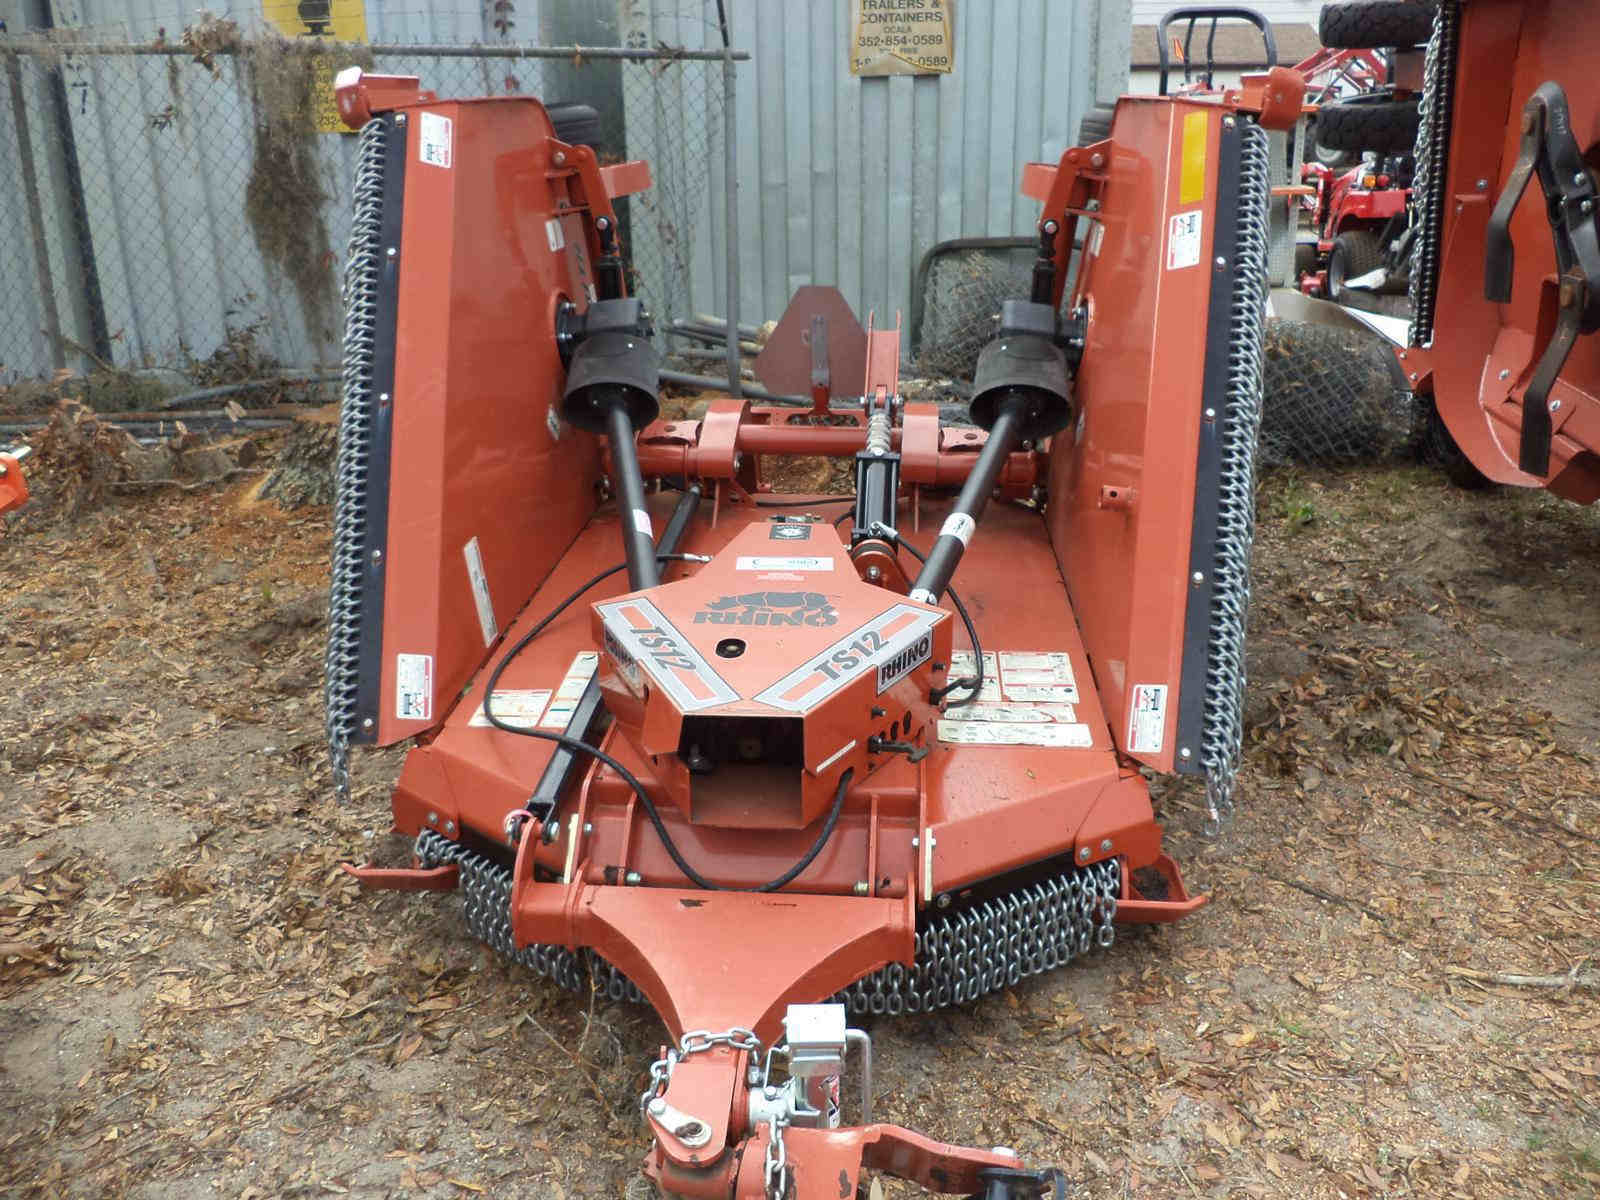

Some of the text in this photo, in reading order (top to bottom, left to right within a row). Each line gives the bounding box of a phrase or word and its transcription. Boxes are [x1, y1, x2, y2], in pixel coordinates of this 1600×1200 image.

[863, 0, 940, 9] TRAILERS &
[863, 11, 943, 23] CONTAINERS
[692, 607, 839, 627] RHINO
[630, 626, 697, 669] TS12
[813, 630, 890, 680] TS12
[881, 636, 930, 686] RHINO
